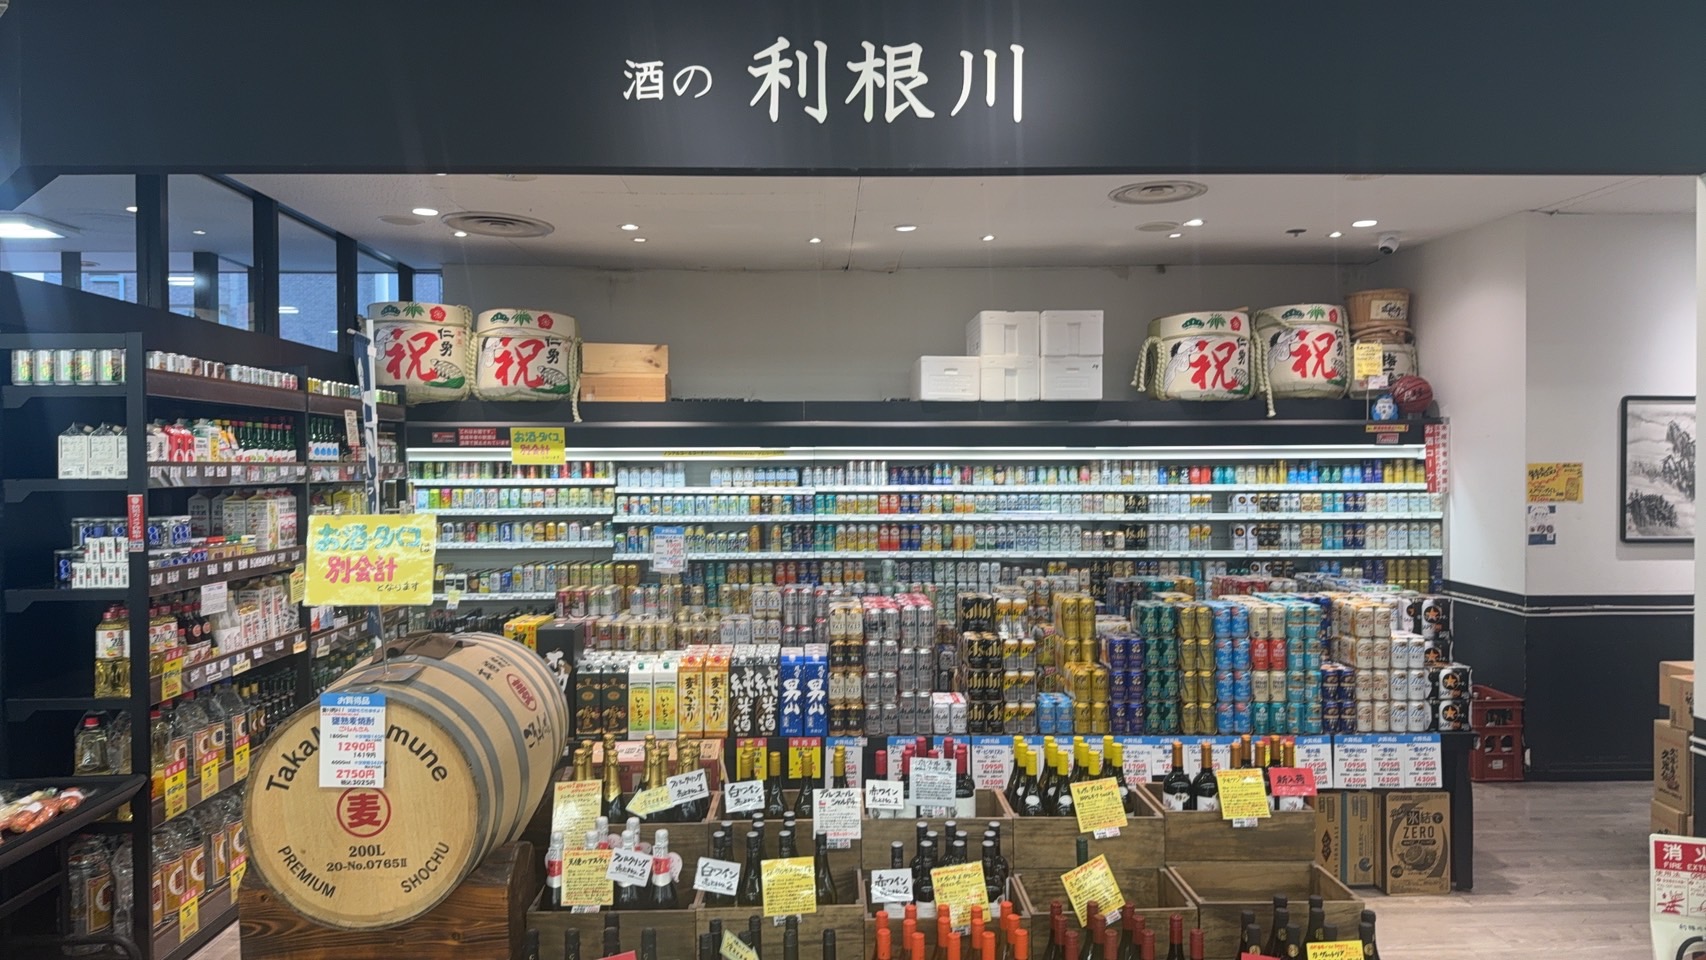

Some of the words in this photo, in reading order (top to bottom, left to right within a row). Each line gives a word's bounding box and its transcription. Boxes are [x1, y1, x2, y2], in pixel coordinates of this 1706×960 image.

[622, 58, 713, 101] 酒の
[747, 36, 1025, 123] 利根川
[385, 328, 439, 381] 祝
[494, 336, 546, 388] 祝
[1189, 340, 1239, 390] 祝
[1290, 329, 1338, 380] 祝
[324, 555, 398, 584] 別会計
[376, 581, 420, 592] となります
[730, 666, 755, 732] 純米酒
[755, 666, 779, 732] 純米酒
[782, 678, 801, 716] 男山
[807, 678, 826, 716] 男山
[337, 742, 376, 752] 1290円
[335, 769, 376, 779] 2750円
[1277, 774, 1305, 785] 新入荷
[728, 784, 761, 799] 白ワイン
[868, 784, 899, 797] 赤ワイン
[347, 793, 382, 829] 麦
[1402, 826, 1435, 838] ZERO
[348, 844, 386, 858] 200L
[1663, 861, 1683, 870] FIRE
[277, 845, 337, 899] PREMIUM
[400, 841, 450, 894] SHOCHU
[700, 861, 739, 879] 白ワイン
[874, 874, 909, 888] 赤ワイン
